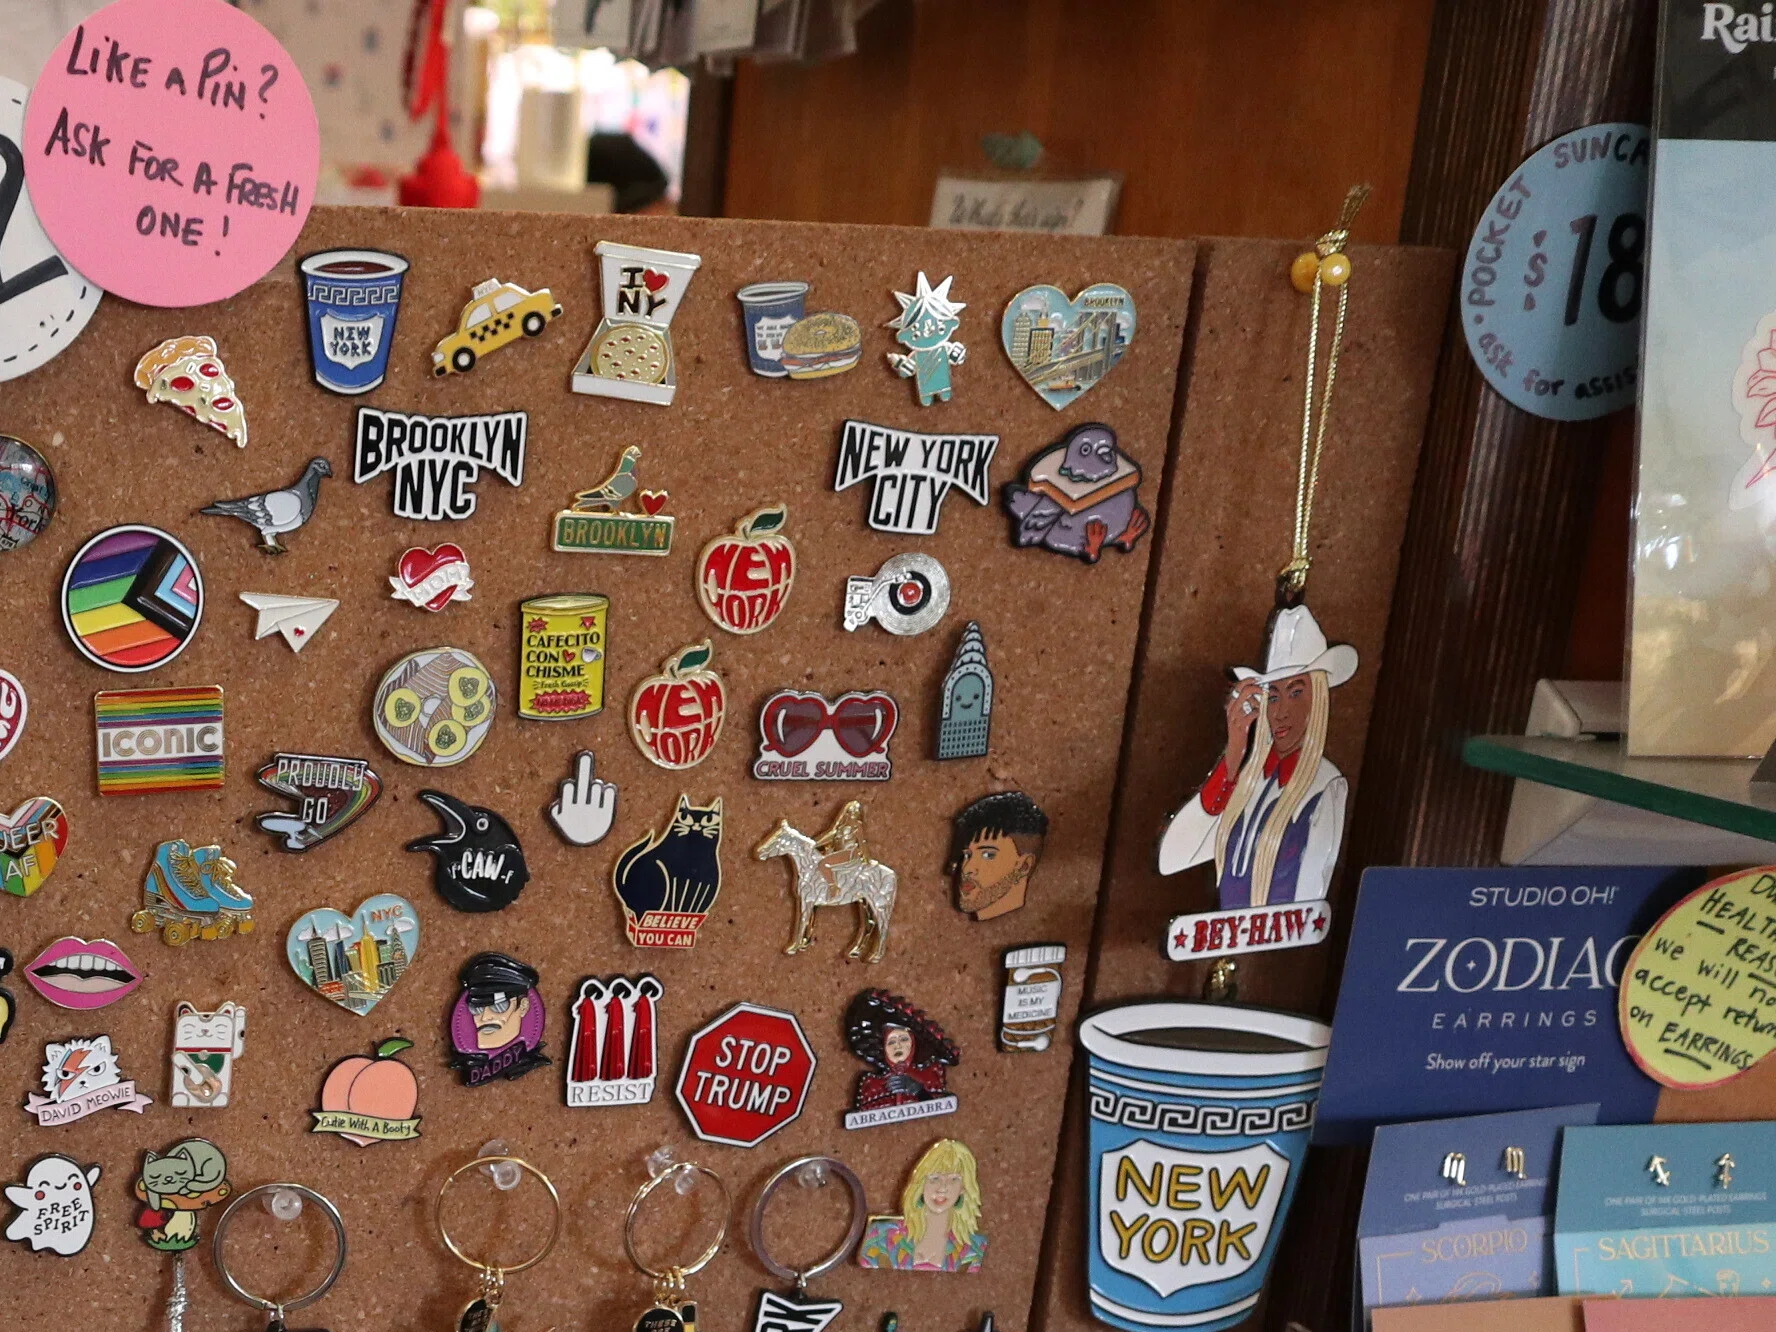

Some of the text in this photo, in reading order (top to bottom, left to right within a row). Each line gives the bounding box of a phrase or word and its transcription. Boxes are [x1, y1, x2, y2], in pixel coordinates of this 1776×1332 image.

[128, 140, 184, 190] FOR
[194, 161, 218, 197] A
[226, 163, 301, 217] FRESH
[1467, 174, 1532, 306] POCKET
[622, 266, 644, 288] I
[617, 289, 667, 318] NY
[1083, 297, 1126, 307] BROOKLYN
[333, 325, 371, 341] NEW
[330, 340, 373, 359] YORK
[1477, 332, 1565, 397] ask for
[358, 411, 524, 485] BROOKLYN
[843, 424, 998, 502] NEW YORK
[399, 459, 474, 519] NYC
[872, 473, 949, 531] CITY
[563, 519, 667, 548] BROOKLYN
[526, 631, 601, 648] CAFECITO
[526, 649, 560, 663] CON
[526, 664, 585, 678] CHISME
[276, 759, 368, 793] PROUDLY
[756, 760, 890, 779] CRUEL SUMMER
[303, 797, 330, 825] GO
[4, 855, 37, 882] AF
[1468, 885, 1617, 907] STUDIO OH!
[371, 905, 404, 922] NYC
[638, 931, 693, 947] YOU CAN
[1191, 907, 1314, 954] BEY-HAW
[1655, 937, 1740, 990] we will
[1017, 985, 1049, 997] MUSIC
[1635, 967, 1712, 1017] accept
[1006, 1009, 1054, 1021] MEDICINE
[1431, 1010, 1599, 1030] EARRINGS
[1630, 1005, 1754, 1071] on EARRINGS
[469, 1047, 525, 1084] DADDY
[714, 1036, 792, 1078] STOP
[1426, 1052, 1586, 1073] Show off your star sign
[40, 1085, 132, 1123] DAVID MEOWIE
[570, 1081, 653, 1103] RESIST
[694, 1070, 791, 1117] TRUMP
[320, 1114, 412, 1138] Cutie With Booty
[848, 1098, 954, 1129] ABRACADABRA
[1115, 1156, 1271, 1211] NEW
[33, 1208, 90, 1236] SPIRIT
[36, 1197, 83, 1221] FREE
[1109, 1210, 1259, 1266] YORK
[1421, 1228, 1528, 1265] SCORPIO
[1597, 1229, 1770, 1262] SAGITTARIUS
[644, 1320, 678, 1330] THESE
